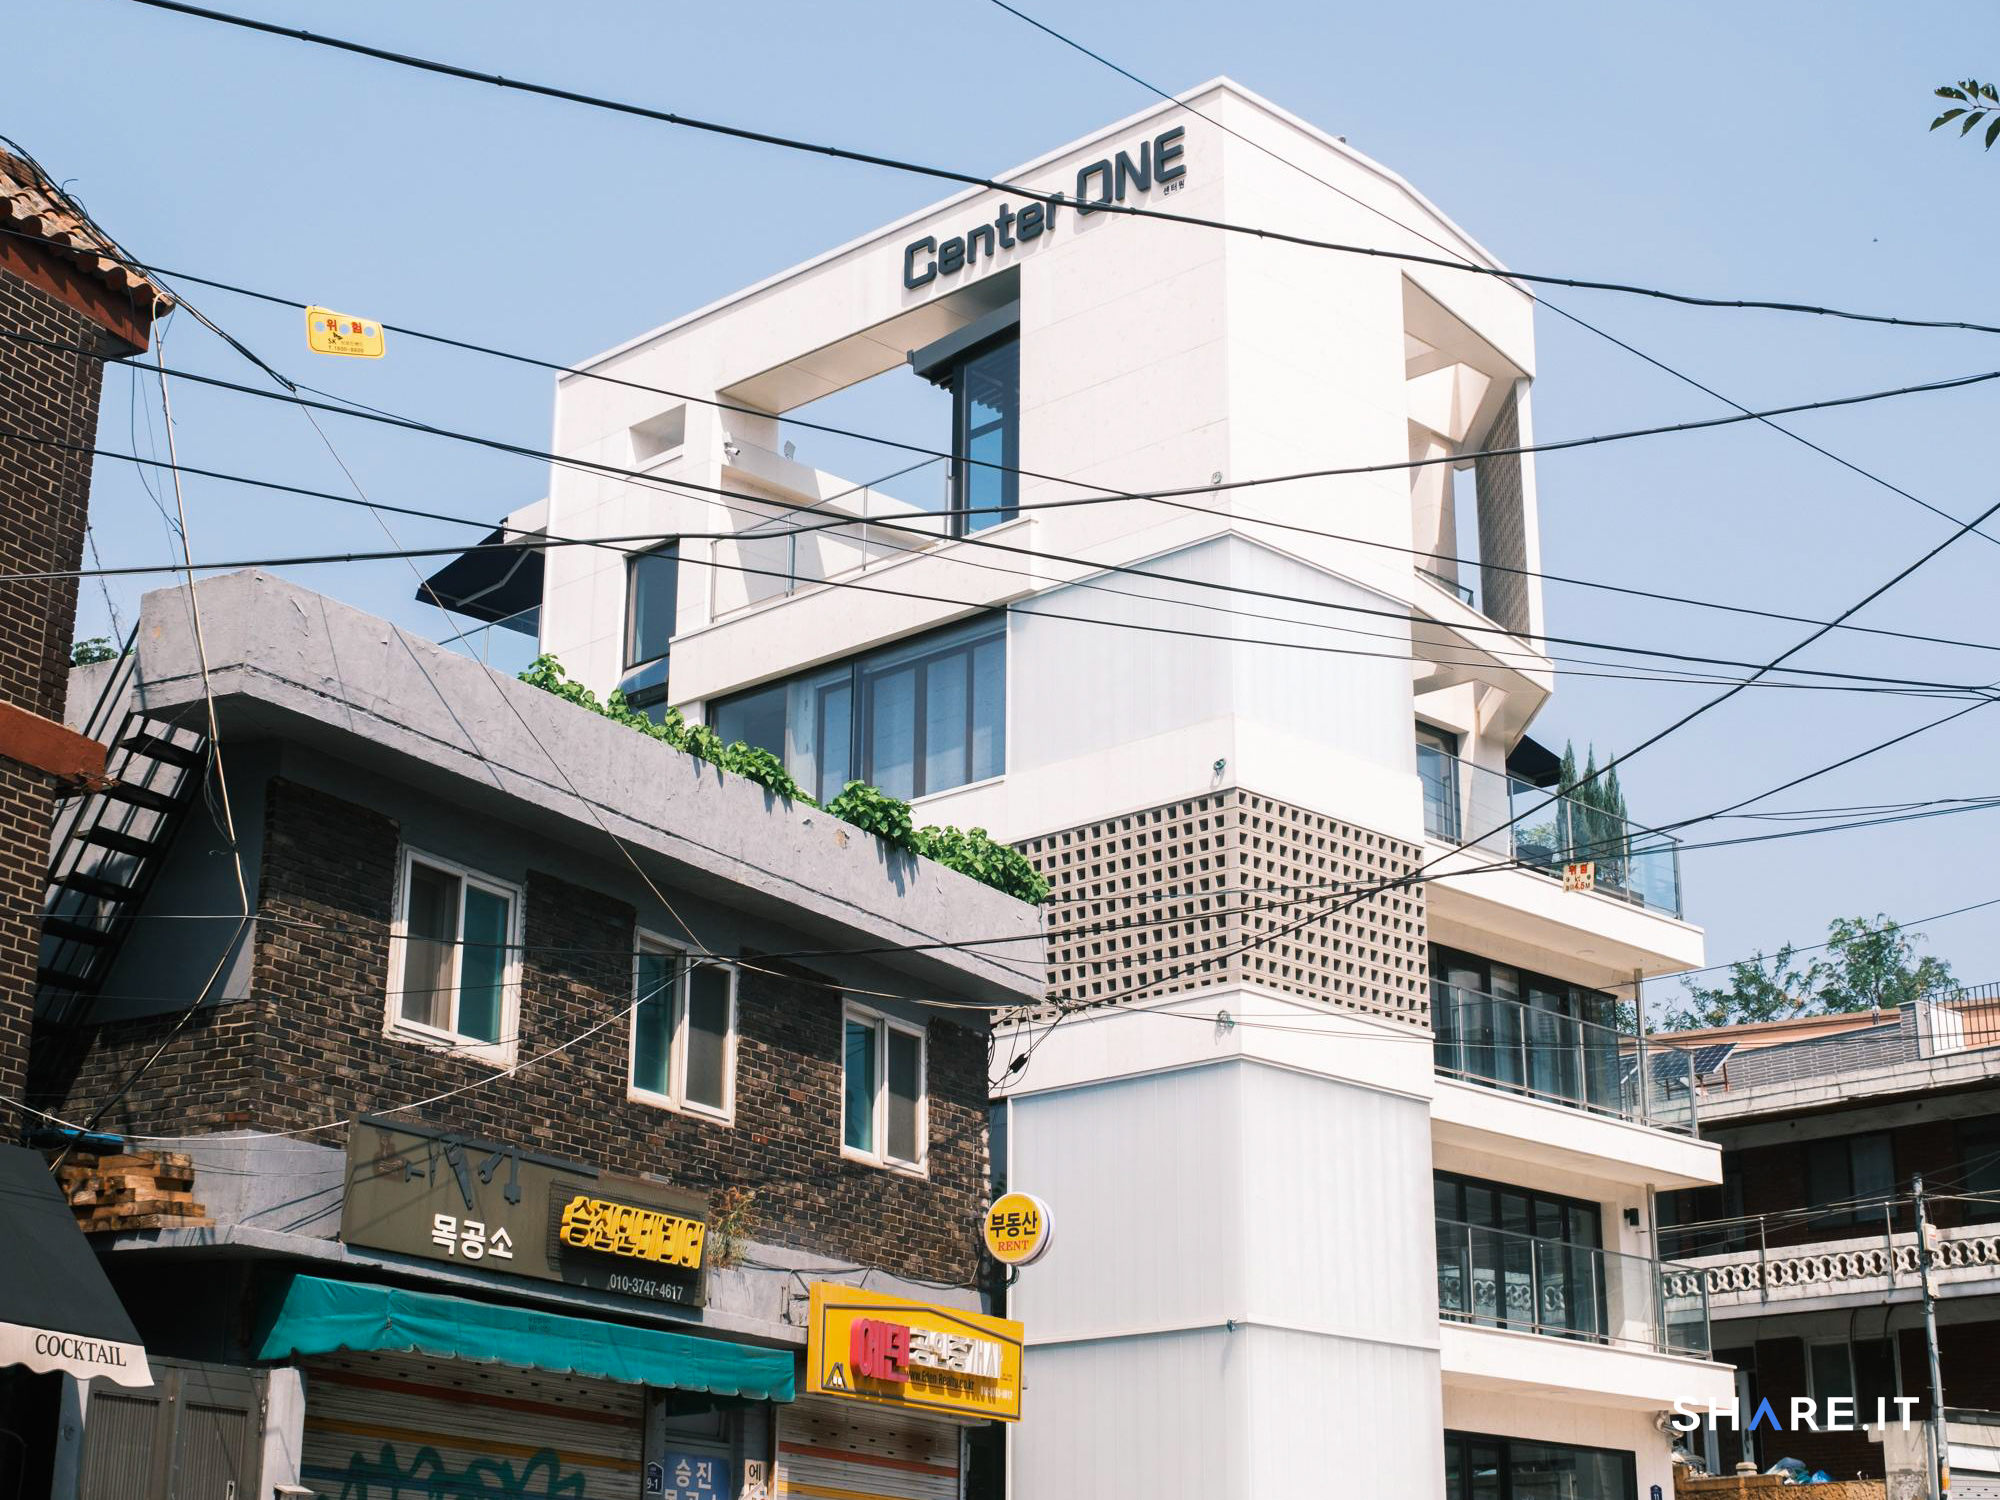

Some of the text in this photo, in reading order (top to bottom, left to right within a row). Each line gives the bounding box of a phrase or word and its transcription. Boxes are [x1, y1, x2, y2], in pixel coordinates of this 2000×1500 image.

[904, 126, 1186, 290] Center ONE
[432, 1213, 513, 1260] 목공소
[560, 1196, 705, 1268] 승진인테리어
[990, 1211, 1038, 1238] 부동산
[998, 1240, 1029, 1252] RENT
[609, 1273, 684, 1300] 010-3747-4617
[35, 1333, 127, 1367] COCKTAIL
[675, 1459, 715, 1490] 승진
